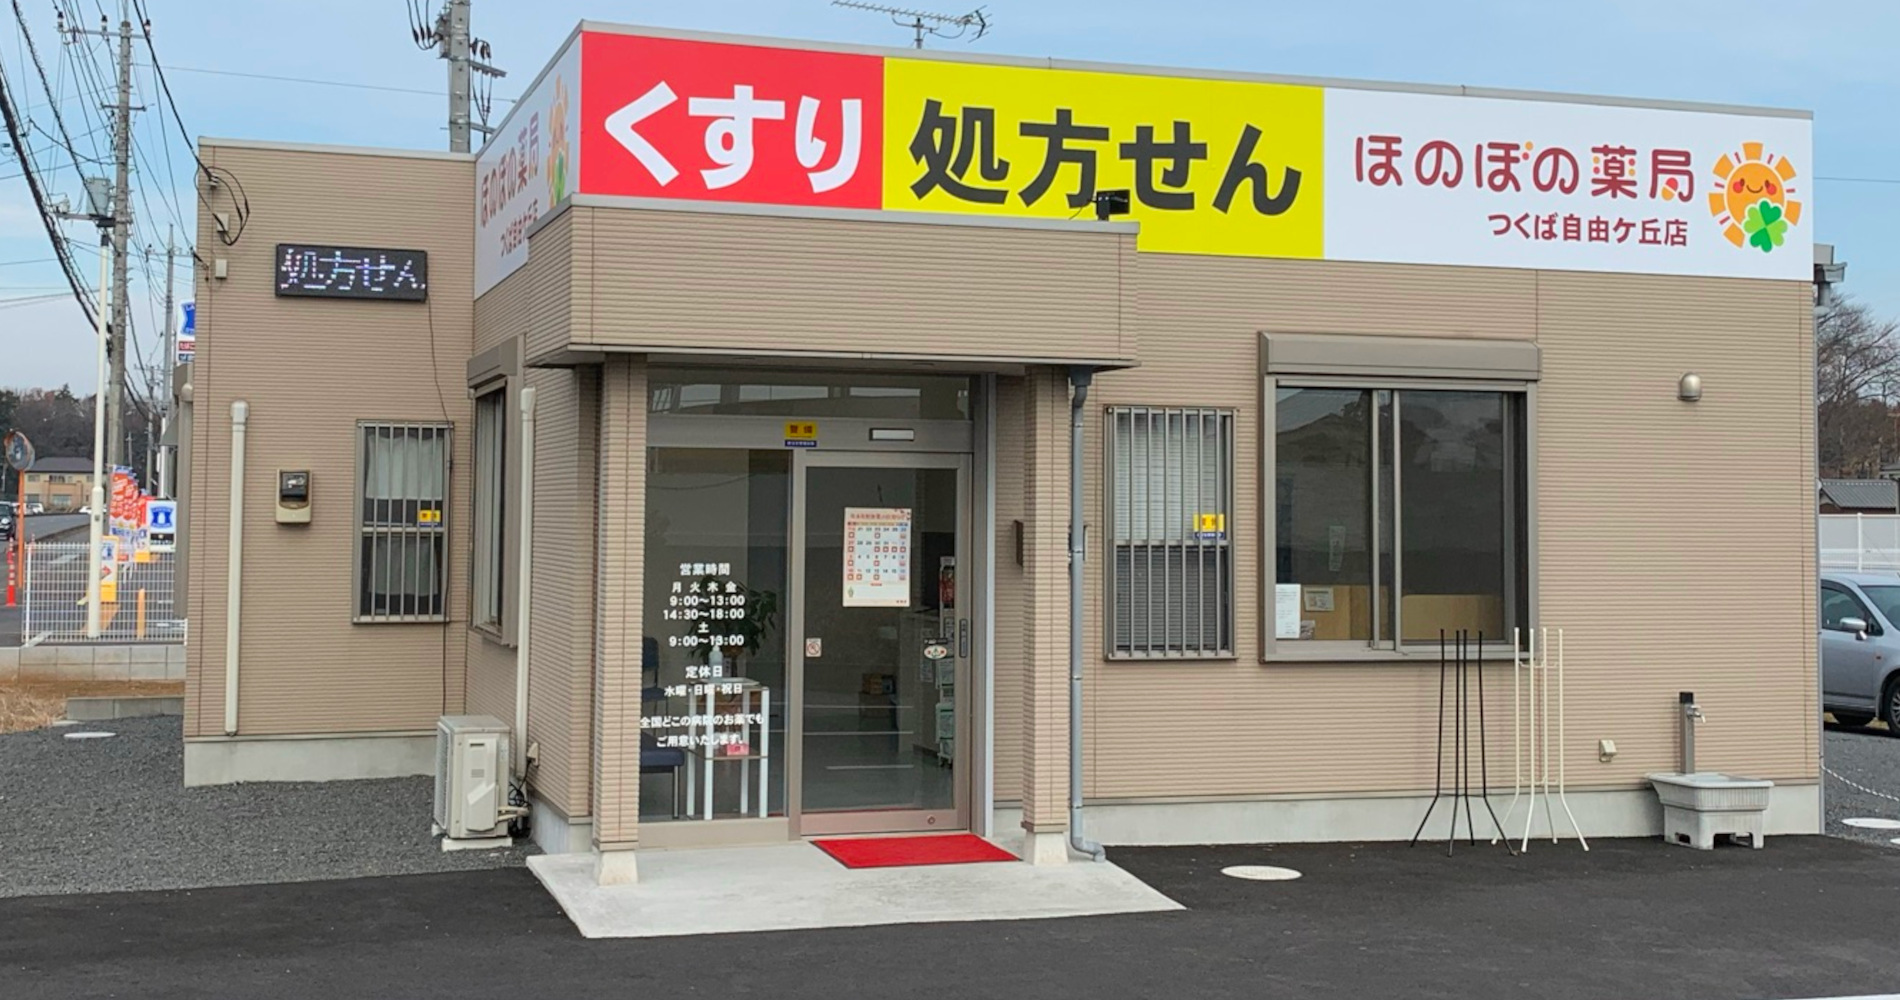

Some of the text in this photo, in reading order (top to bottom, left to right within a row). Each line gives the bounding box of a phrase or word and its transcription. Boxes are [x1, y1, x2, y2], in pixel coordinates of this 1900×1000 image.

[604, 80, 862, 193] くすり
[909, 98, 1302, 216] 処方せん
[1355, 134, 1694, 202] ほのぼの薬局
[1488, 212, 1687, 246] つくば自由ケ丘店
[280, 248, 426, 292] 処方せん
[680, 563, 731, 576] 営業時間
[672, 581, 737, 593] 月 火 木 金
[698, 621, 709, 633] 土
[685, 665, 723, 678] 定休日
